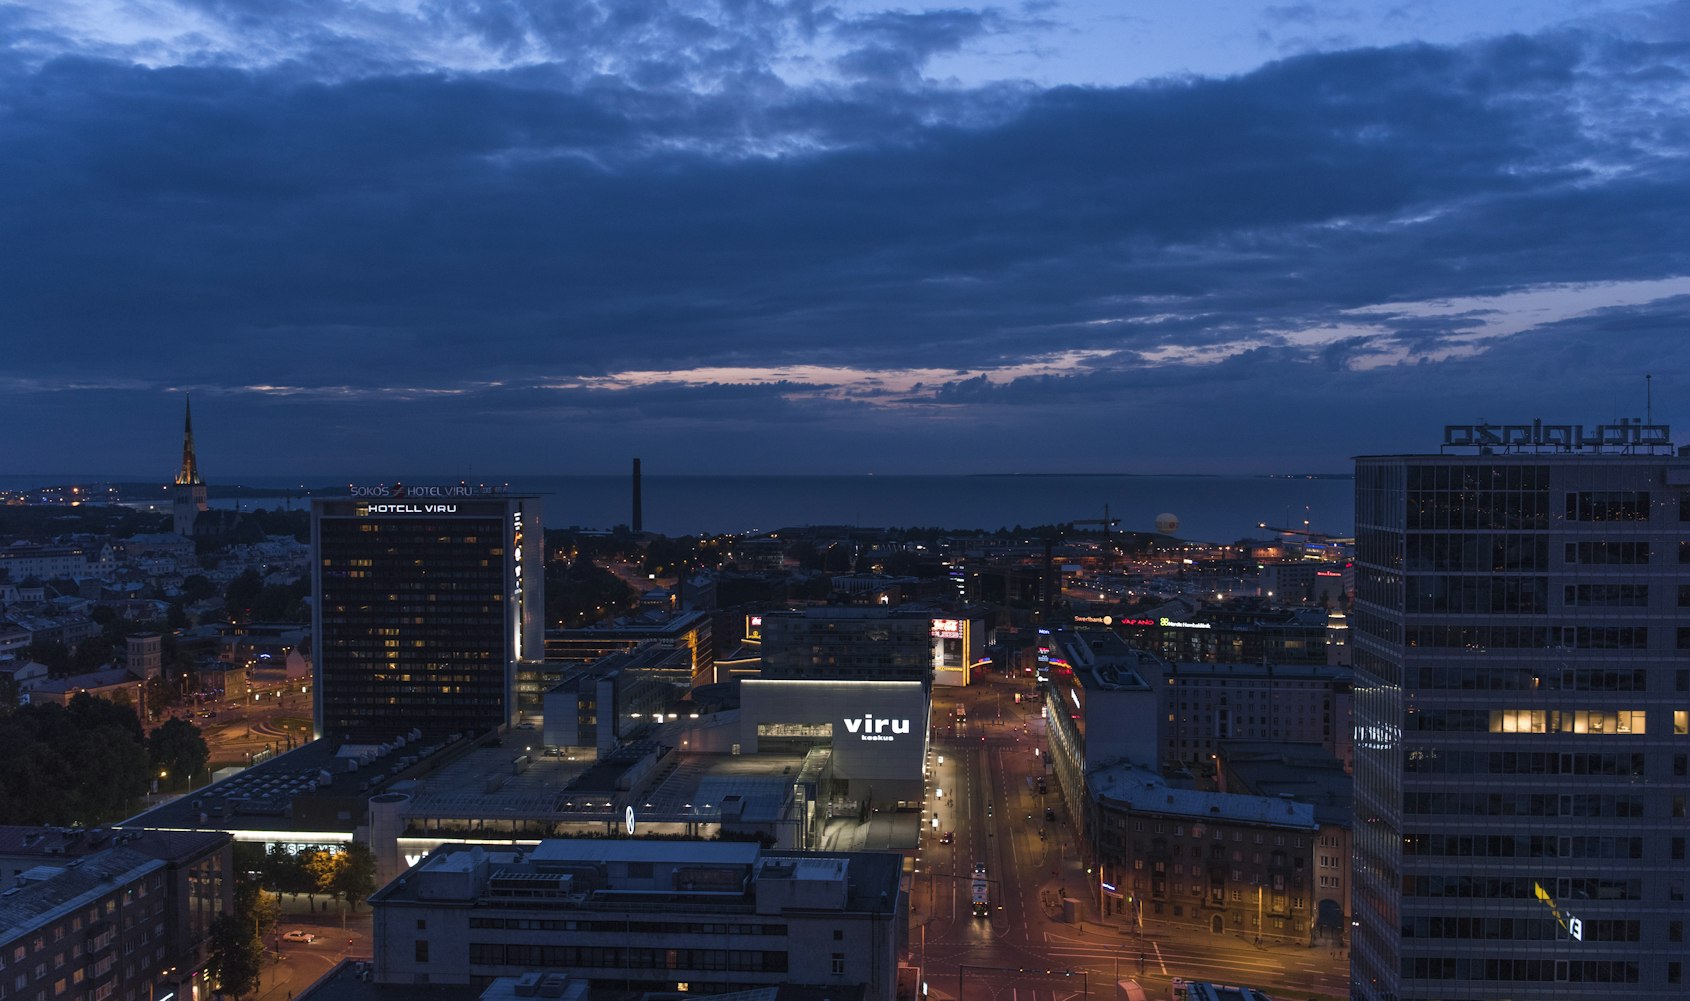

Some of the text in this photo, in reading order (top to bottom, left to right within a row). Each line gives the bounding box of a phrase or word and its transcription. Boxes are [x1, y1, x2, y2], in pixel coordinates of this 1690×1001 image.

[351, 487, 473, 496] SOKOS HOTEL VIRU
[368, 505, 457, 513] HOTELL VIRU
[1121, 618, 1155, 626] VAPANO
[843, 714, 909, 734] viru
